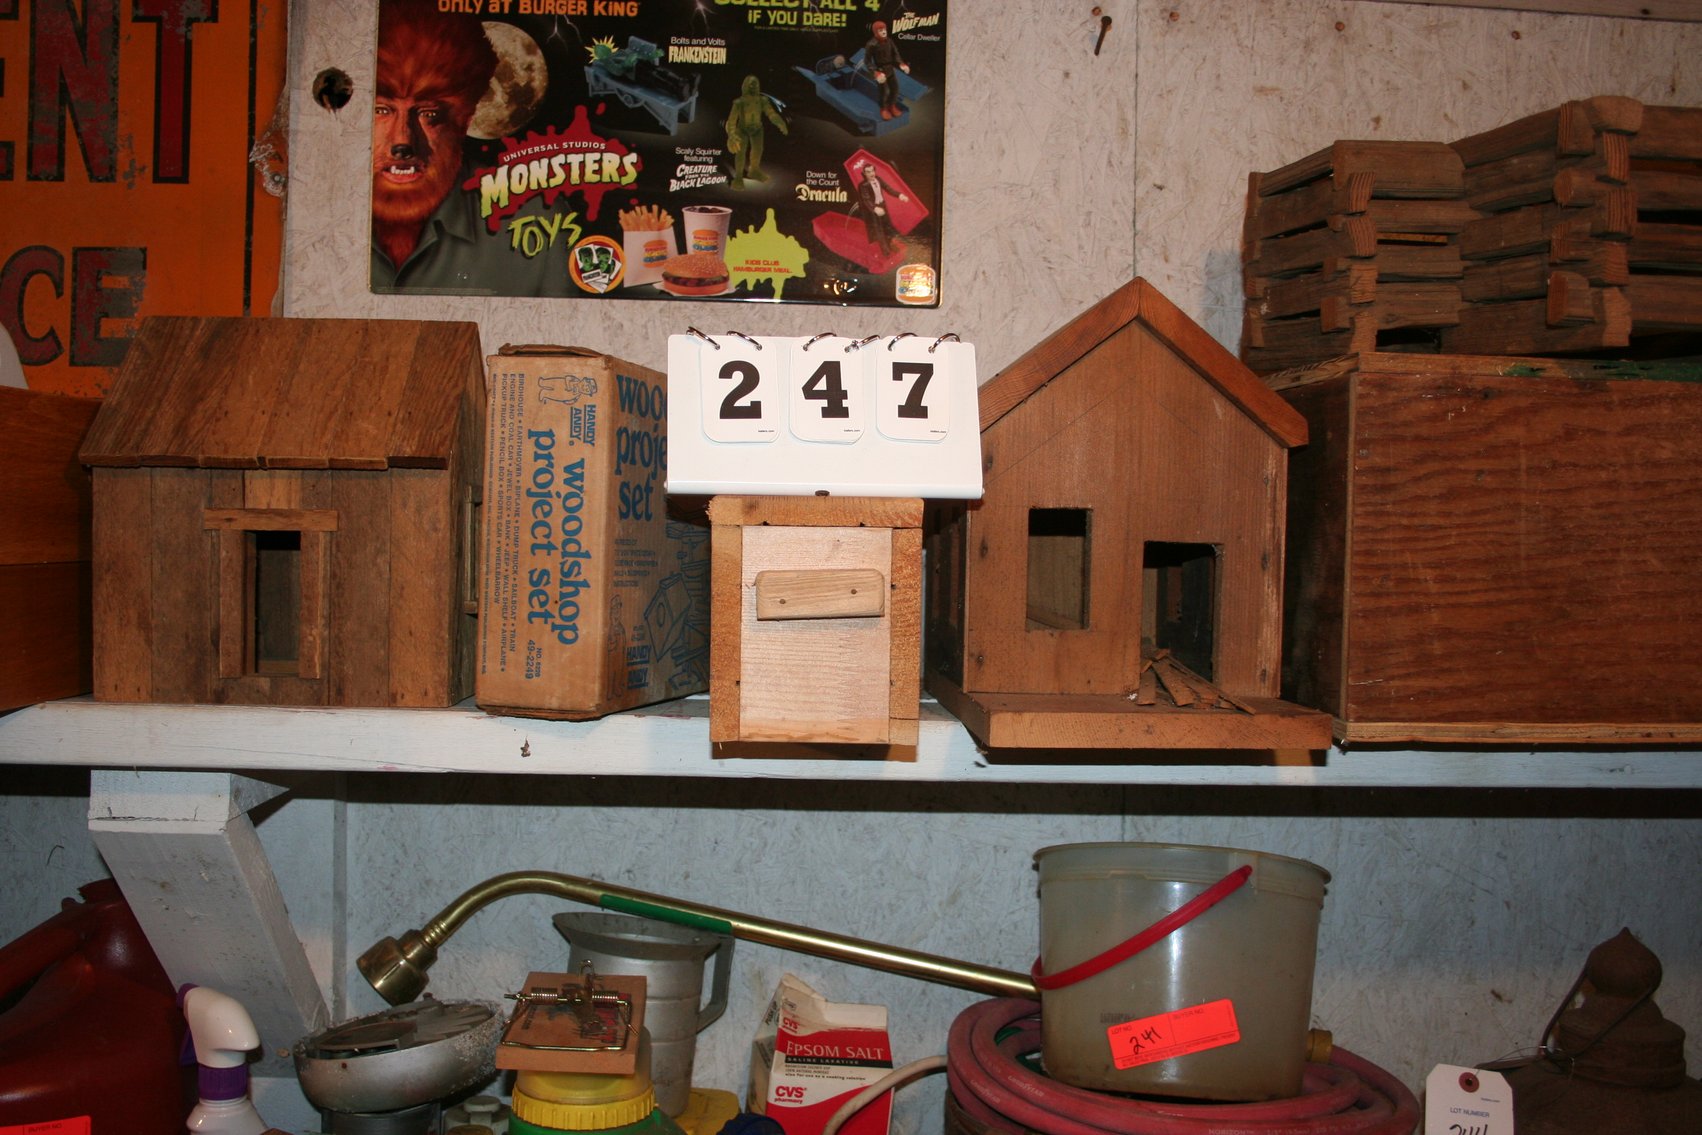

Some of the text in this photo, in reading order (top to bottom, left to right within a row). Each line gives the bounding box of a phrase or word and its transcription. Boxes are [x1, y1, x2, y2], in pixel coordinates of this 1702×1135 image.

[518, 0, 587, 16] BURGER
[768, 10, 797, 26] YOU
[670, 36, 690, 45] Bolts
[707, 38, 726, 46] Volts
[668, 46, 727, 65] FRANKENSTEIN
[0, 0, 218, 183] NT
[503, 141, 607, 163] UNIVERSAL STUDIOS
[675, 147, 722, 156] Scaly Squirter
[683, 155, 713, 164] featuring
[676, 163, 718, 178] CREATURE
[806, 170, 838, 179] Down for
[480, 152, 639, 219] MONSTERS
[669, 175, 727, 192] BLACK LAGOON
[795, 183, 848, 203] Dracula
[818, 178, 840, 186] Count
[508, 211, 582, 257] TOYS
[517, 373, 525, 418] BIRDHOUSE
[616, 374, 667, 421] woo
[507, 422, 515, 443] COAL
[573, 407, 582, 441] ANDY
[585, 404, 596, 447] HANDY
[498, 436, 506, 464] PENCIL
[496, 490, 504, 520] SPORTS
[618, 471, 654, 522] set
[526, 428, 561, 625] project set
[551, 457, 592, 645] woodshop
[493, 546, 502, 605] WHEELBARROW
[502, 574, 510, 595] WALL
[501, 597, 509, 622] SHELF
[510, 583, 518, 620] SAILBOAT
[500, 628, 508, 666] AIRPLANE
[783, 1016, 799, 1030] CVS
[786, 1041, 840, 1057] EPSOM
[846, 1046, 884, 1060] SALT
[1129, 1026, 1162, 1055] 241
[775, 1085, 804, 1098] CVS
[1463, 1108, 1490, 1118] NUMBER
